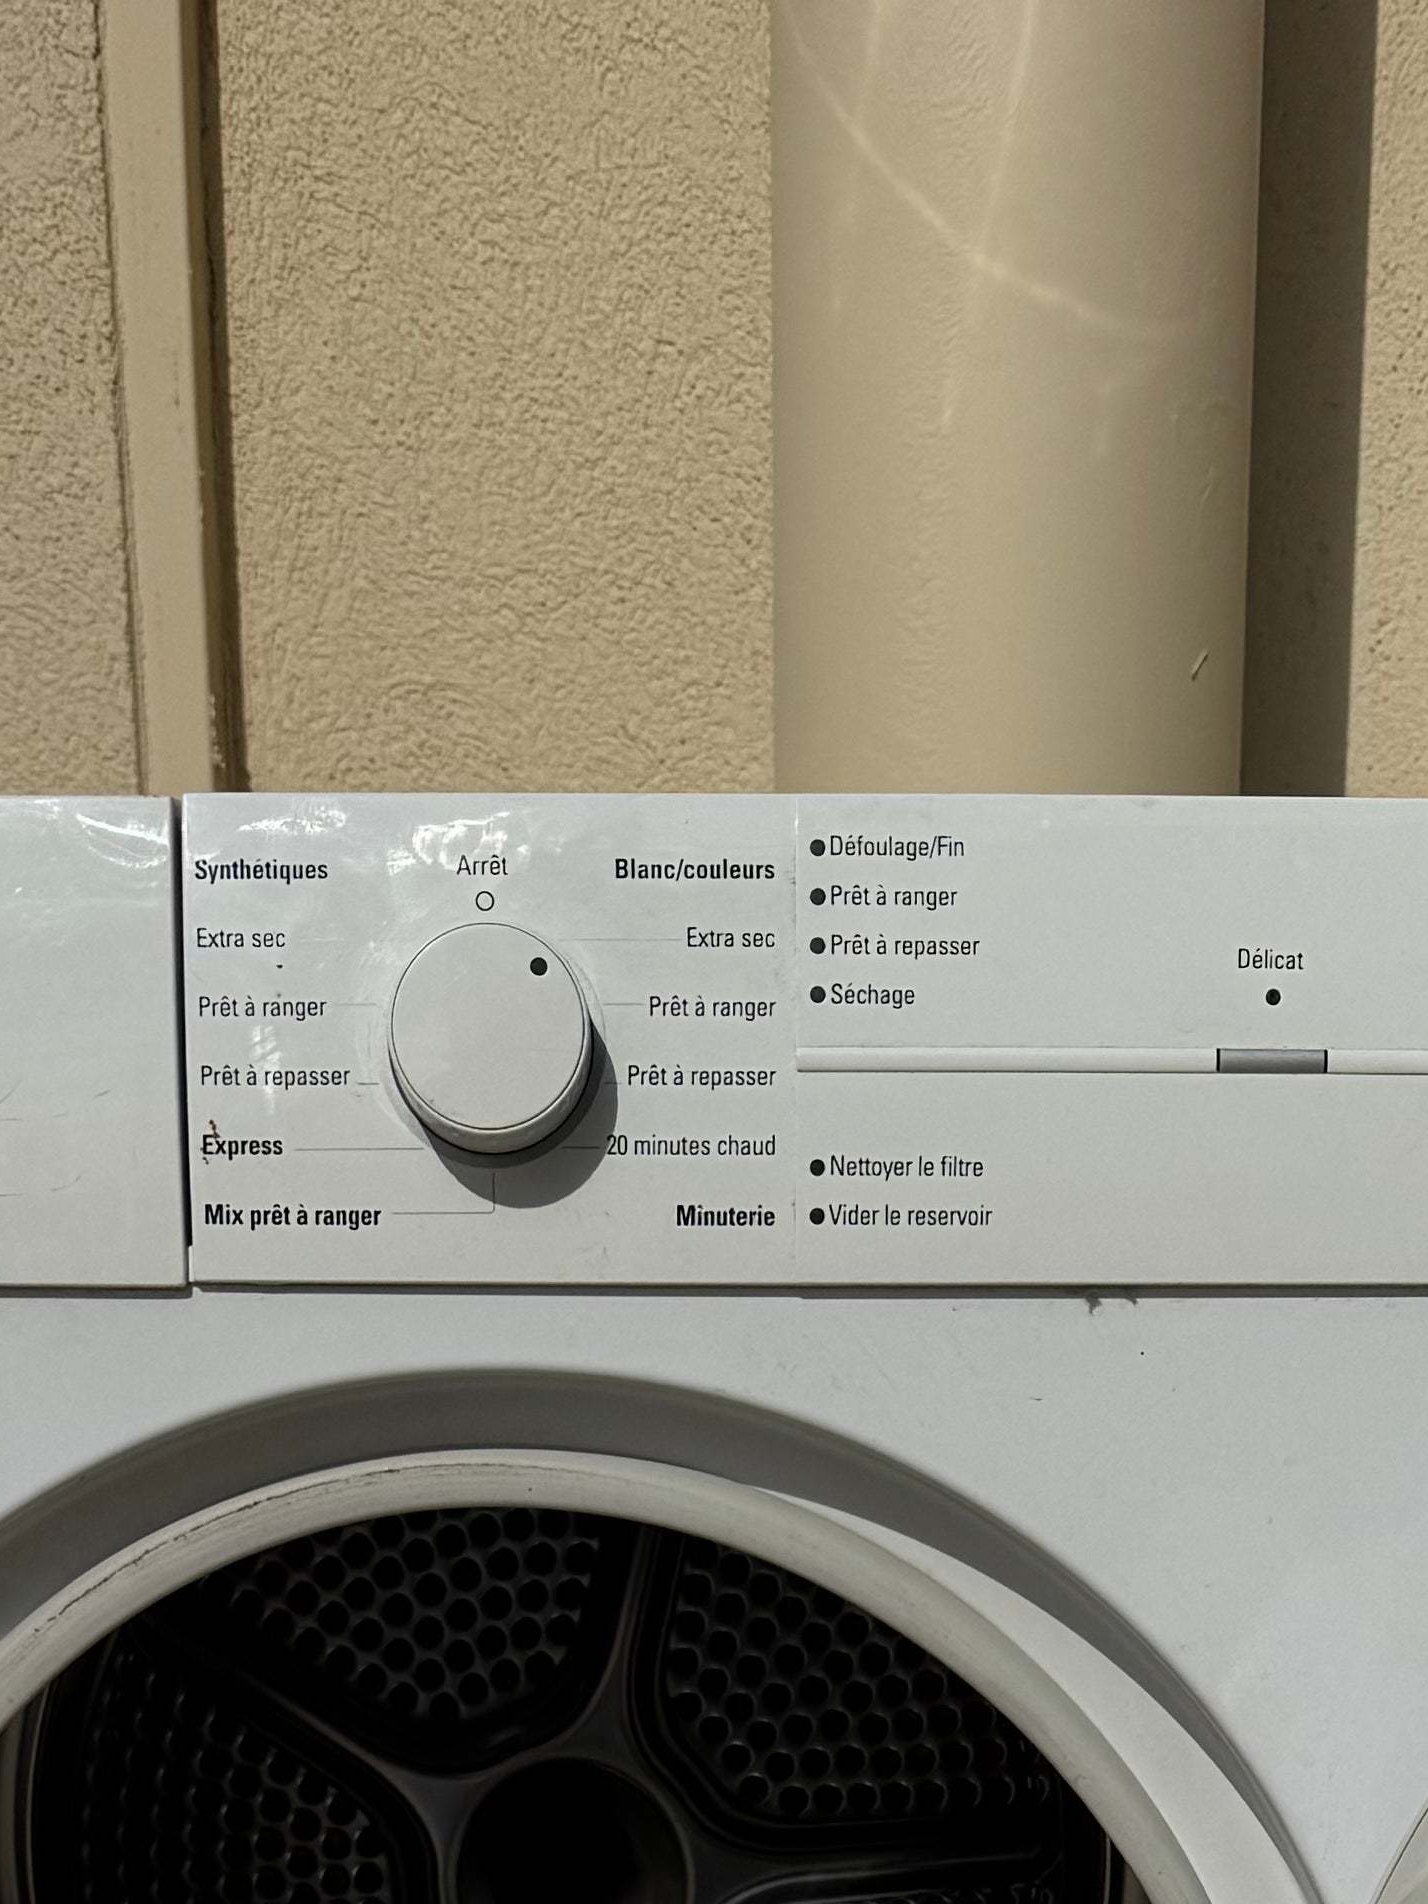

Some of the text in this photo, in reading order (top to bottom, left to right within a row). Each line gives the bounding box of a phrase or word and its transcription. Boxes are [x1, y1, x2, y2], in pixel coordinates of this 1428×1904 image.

[830, 835, 964, 860] Défoulage/Fin
[194, 858, 328, 885] Synthétiques
[456, 854, 508, 876] Arrêt
[615, 858, 775, 882] Blanc/couleurs
[830, 884, 958, 911] Prêt à ranger
[196, 927, 286, 948] Extra sec
[687, 926, 775, 948] Extra sec
[831, 933, 981, 960] Prêt à repasser
[1238, 947, 1304, 970] Délicat
[198, 995, 327, 1022] Prêt à ranger
[649, 994, 777, 1022] Prêt à ranger
[830, 983, 915, 1009] Séchage
[200, 1063, 351, 1091] Prêt à repasser
[627, 1064, 777, 1091] Prêt à repasser
[201, 1136, 284, 1159] Express
[605, 1134, 776, 1156] 20 minutes chaud
[830, 1155, 984, 1181] Nettoyer le filtre
[204, 1203, 382, 1232] Mix prêt à ranger
[676, 1204, 776, 1227] Minuterie
[828, 1203, 993, 1226] Vider le reservoir
